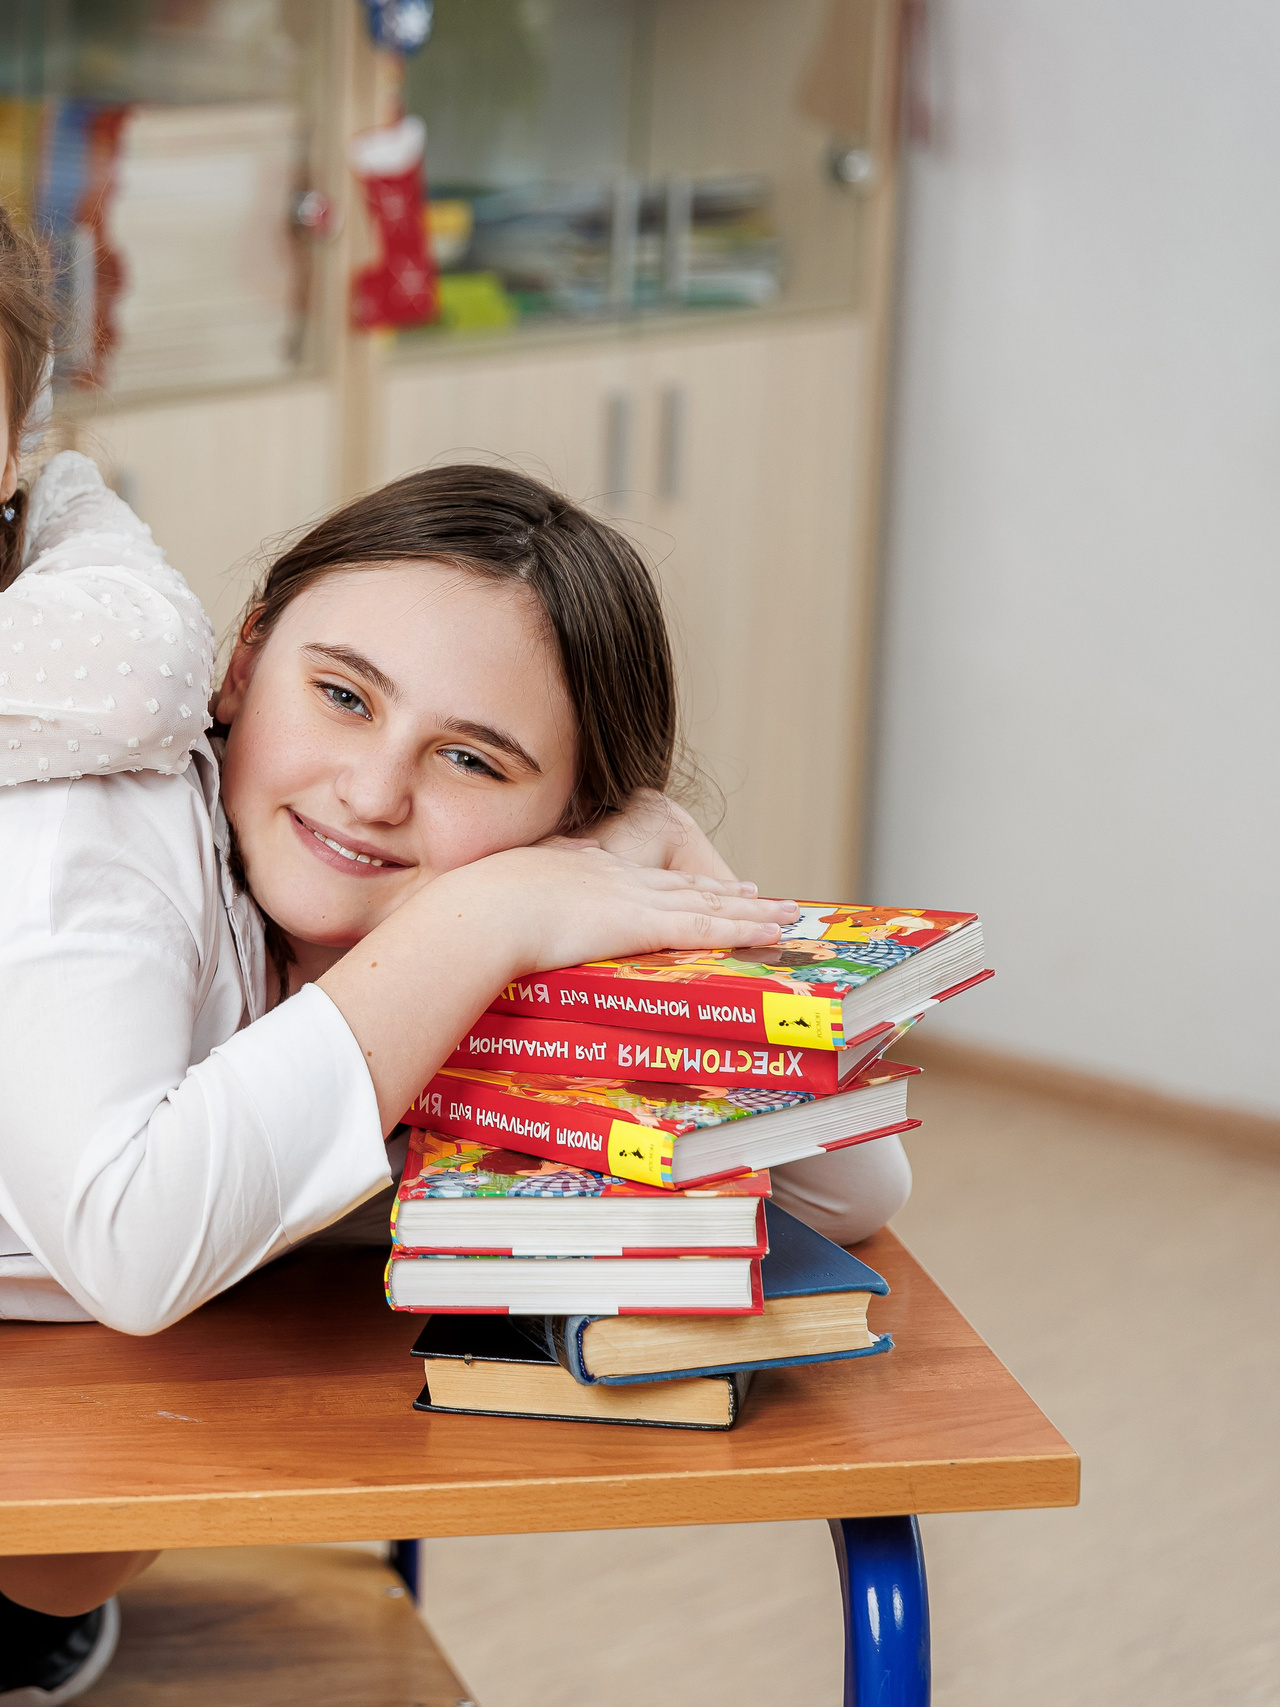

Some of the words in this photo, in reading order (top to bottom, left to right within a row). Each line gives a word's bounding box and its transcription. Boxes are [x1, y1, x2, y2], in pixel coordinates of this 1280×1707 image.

[593, 993, 691, 1019] НАЧАЛЬНОЙ
[697, 1004, 757, 1024] ШКОЛЫ
[469, 1035, 569, 1059] НАЧАЛЬНОЙ
[617, 1043, 804, 1078] ХРЕСТОМАТИЯ
[476, 1107, 551, 1143] НАЧАЛЬНОЙ
[556, 1127, 603, 1152] ШКОЛЫ
